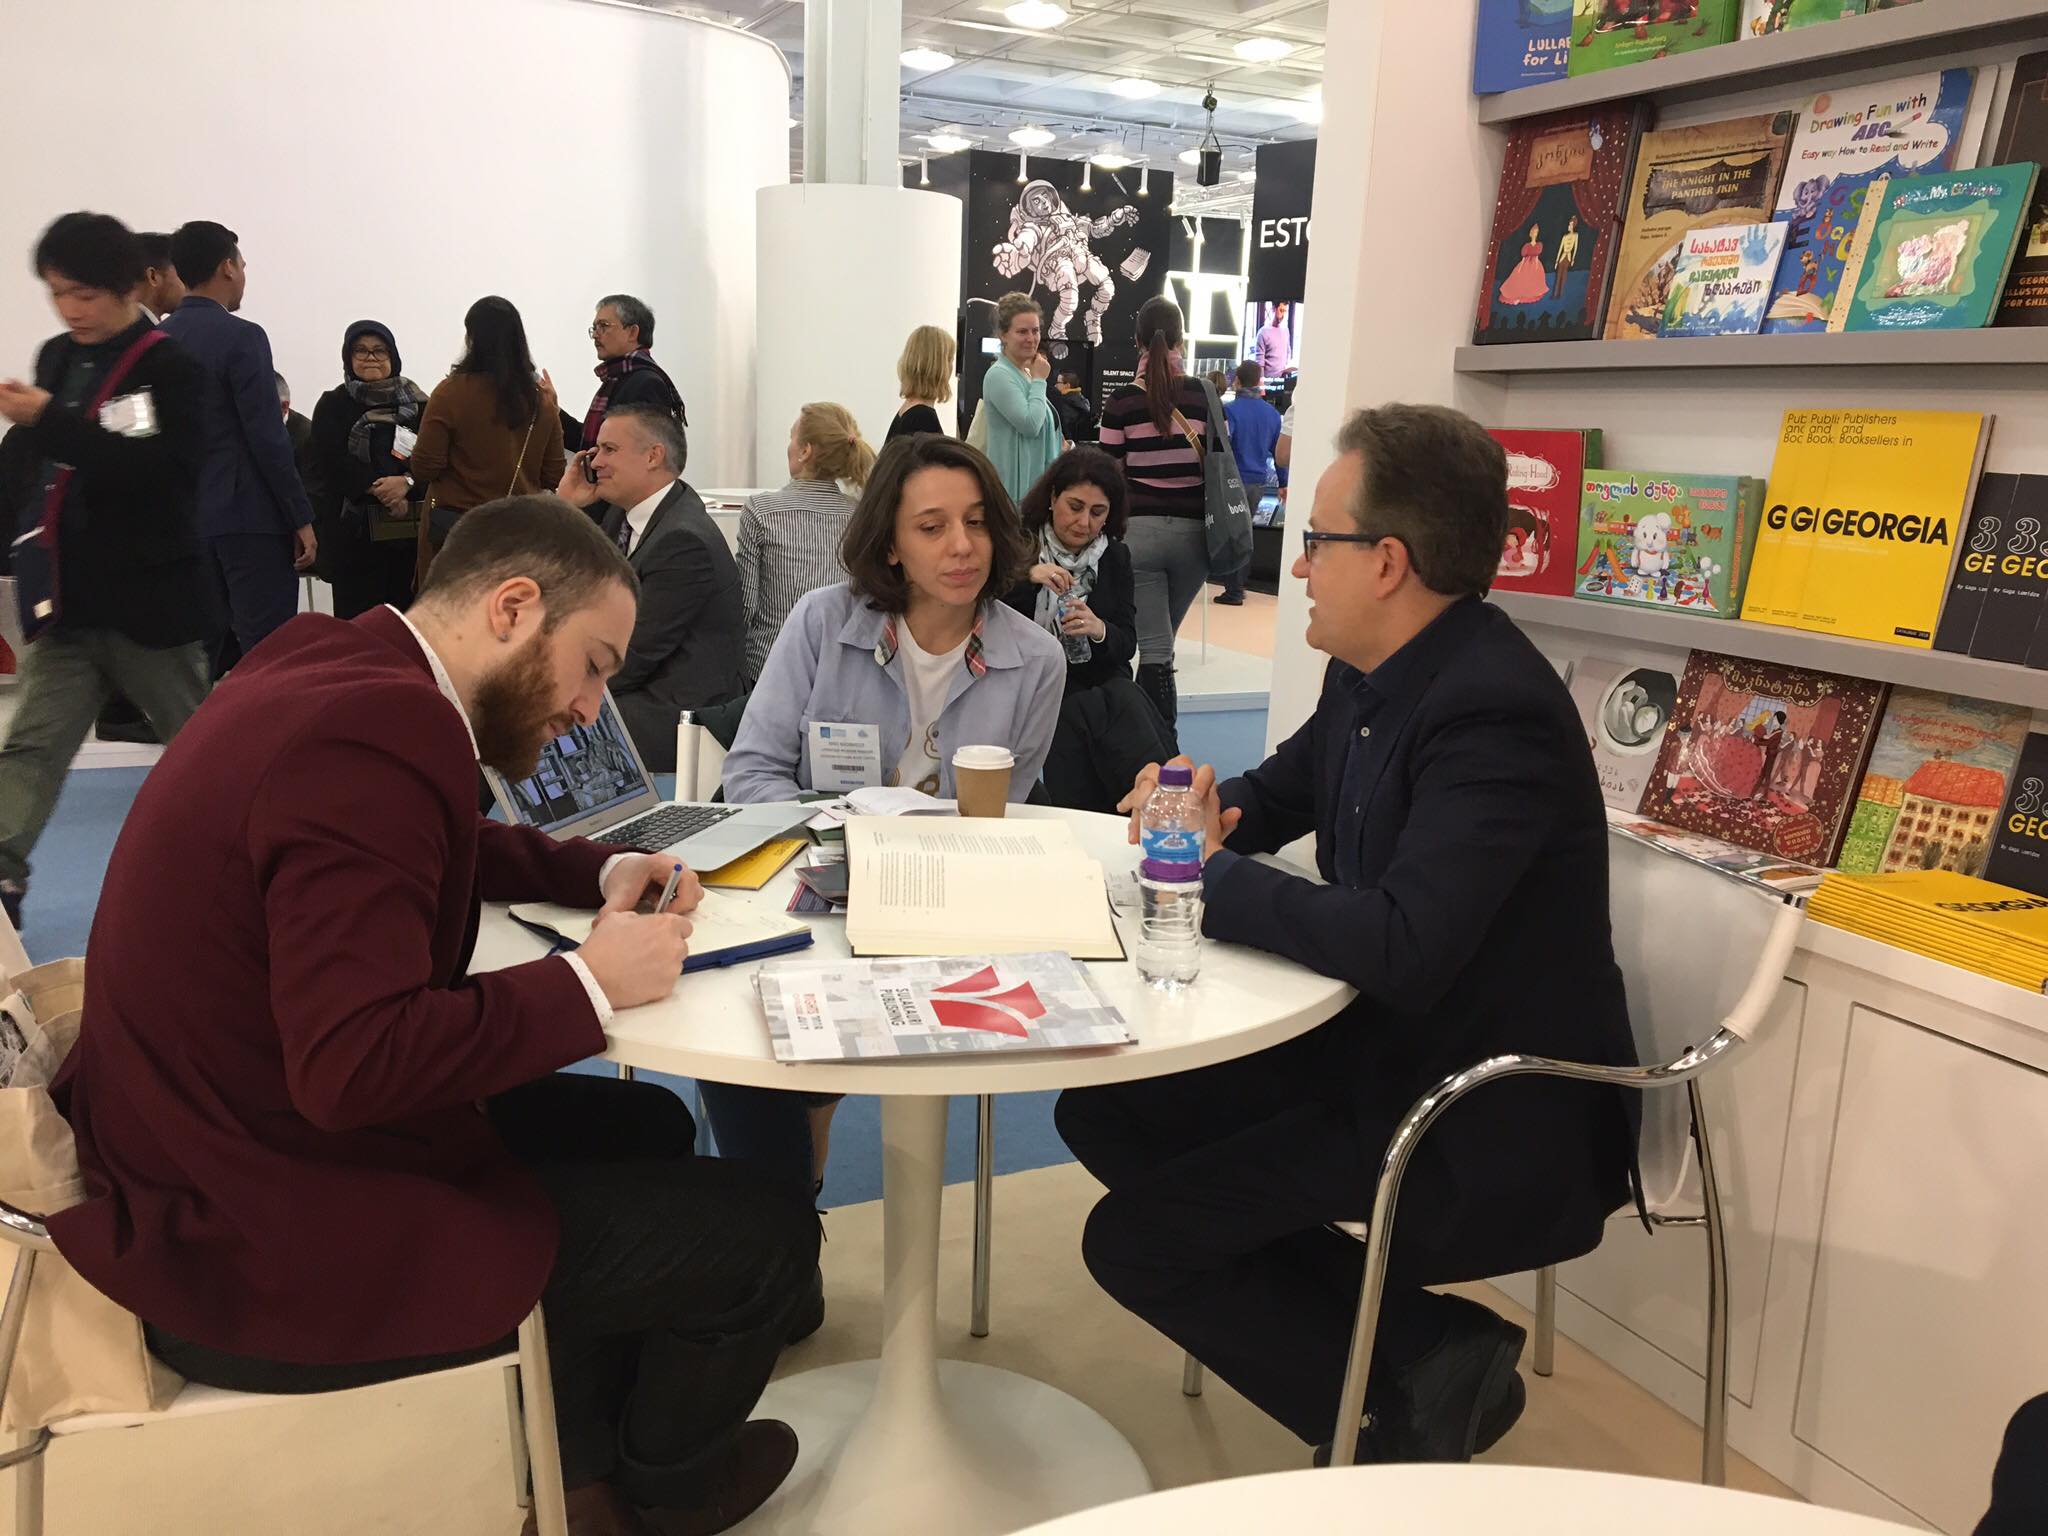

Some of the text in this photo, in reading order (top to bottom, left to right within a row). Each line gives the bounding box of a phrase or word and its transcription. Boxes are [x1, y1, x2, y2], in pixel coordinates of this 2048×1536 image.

[1523, 53, 1548, 66] for
[1810, 93, 1927, 133] Drawing Fun with
[1851, 120, 1892, 141] ABC
[1801, 150, 1820, 160] Easy
[1821, 150, 1838, 158] way
[1838, 147, 1856, 156] How
[1869, 143, 1891, 153] Read
[1893, 142, 1909, 151] and
[1912, 138, 1938, 150] Write
[1662, 168, 1752, 189] THE KNIGHT IN THE
[1671, 183, 1739, 200] PANTHER SKIN
[1809, 423, 1832, 434] and
[1843, 413, 1897, 425] Publishers
[1842, 424, 1864, 434] and
[1839, 432, 1913, 446] Booksellers in
[1823, 508, 1949, 546] GEORGIA
[1964, 552, 1997, 574] GE
